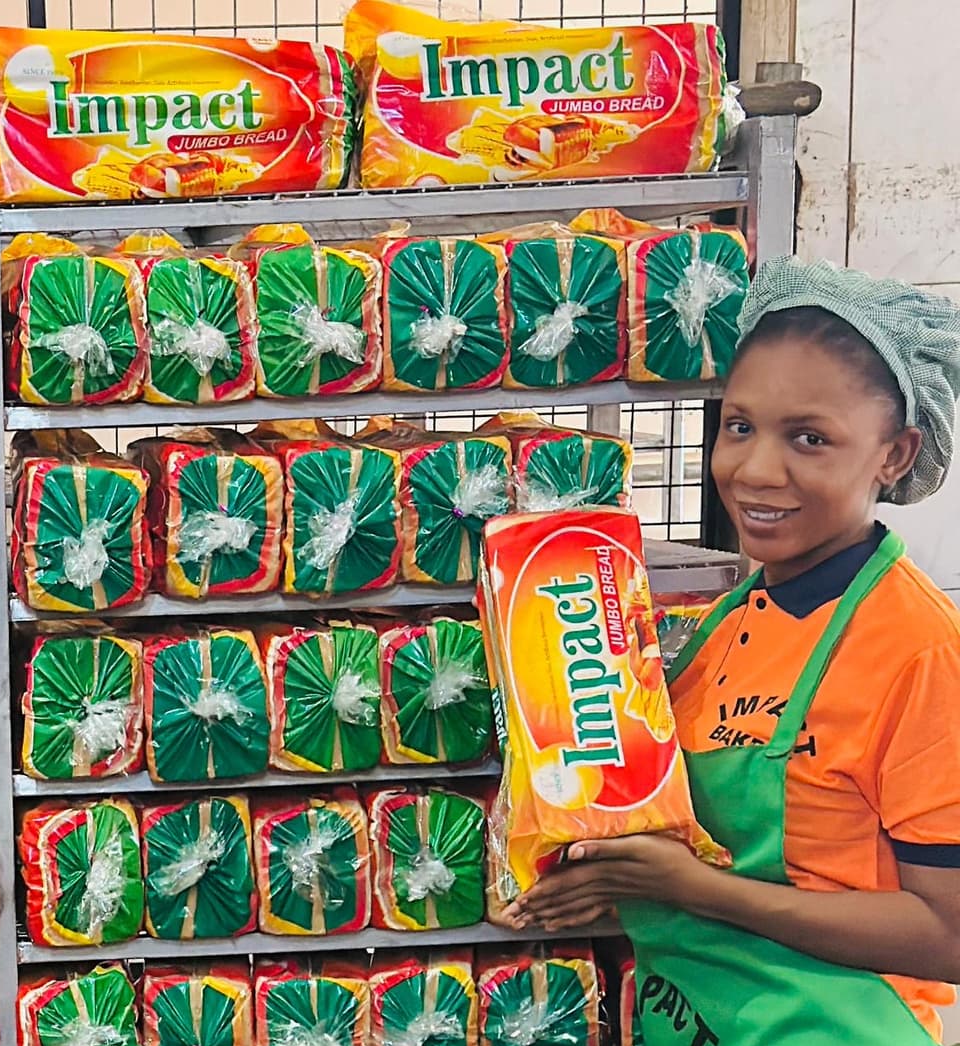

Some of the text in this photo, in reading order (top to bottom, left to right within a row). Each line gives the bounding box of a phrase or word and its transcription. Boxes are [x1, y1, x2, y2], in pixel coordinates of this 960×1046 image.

[422, 33, 634, 107] Impact
[548, 96, 665, 114] JUMBO BREAD
[48, 80, 263, 146] Impact
[174, 128, 288, 151] JUMBO BREAD
[596, 545, 624, 649] JUMBO BREAD
[536, 574, 624, 768] Impact
